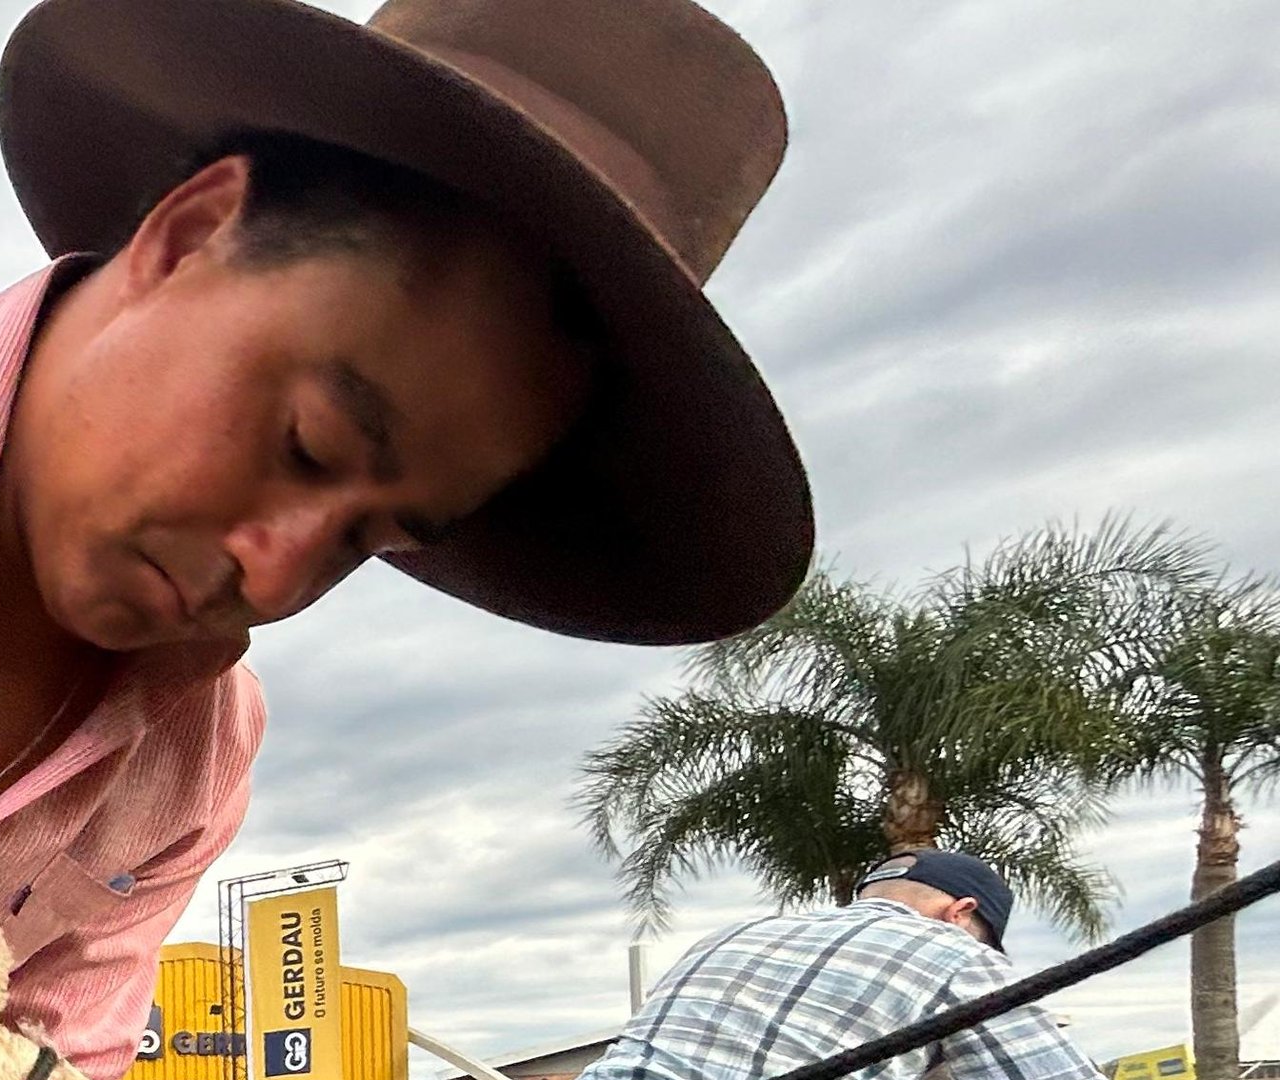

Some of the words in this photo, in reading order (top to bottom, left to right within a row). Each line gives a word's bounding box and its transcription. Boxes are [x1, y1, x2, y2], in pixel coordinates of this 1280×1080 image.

[310, 908, 323, 947] molda
[281, 912, 305, 1021] GERDAU
[314, 949, 324, 965] se
[314, 967, 326, 1006] futuro
